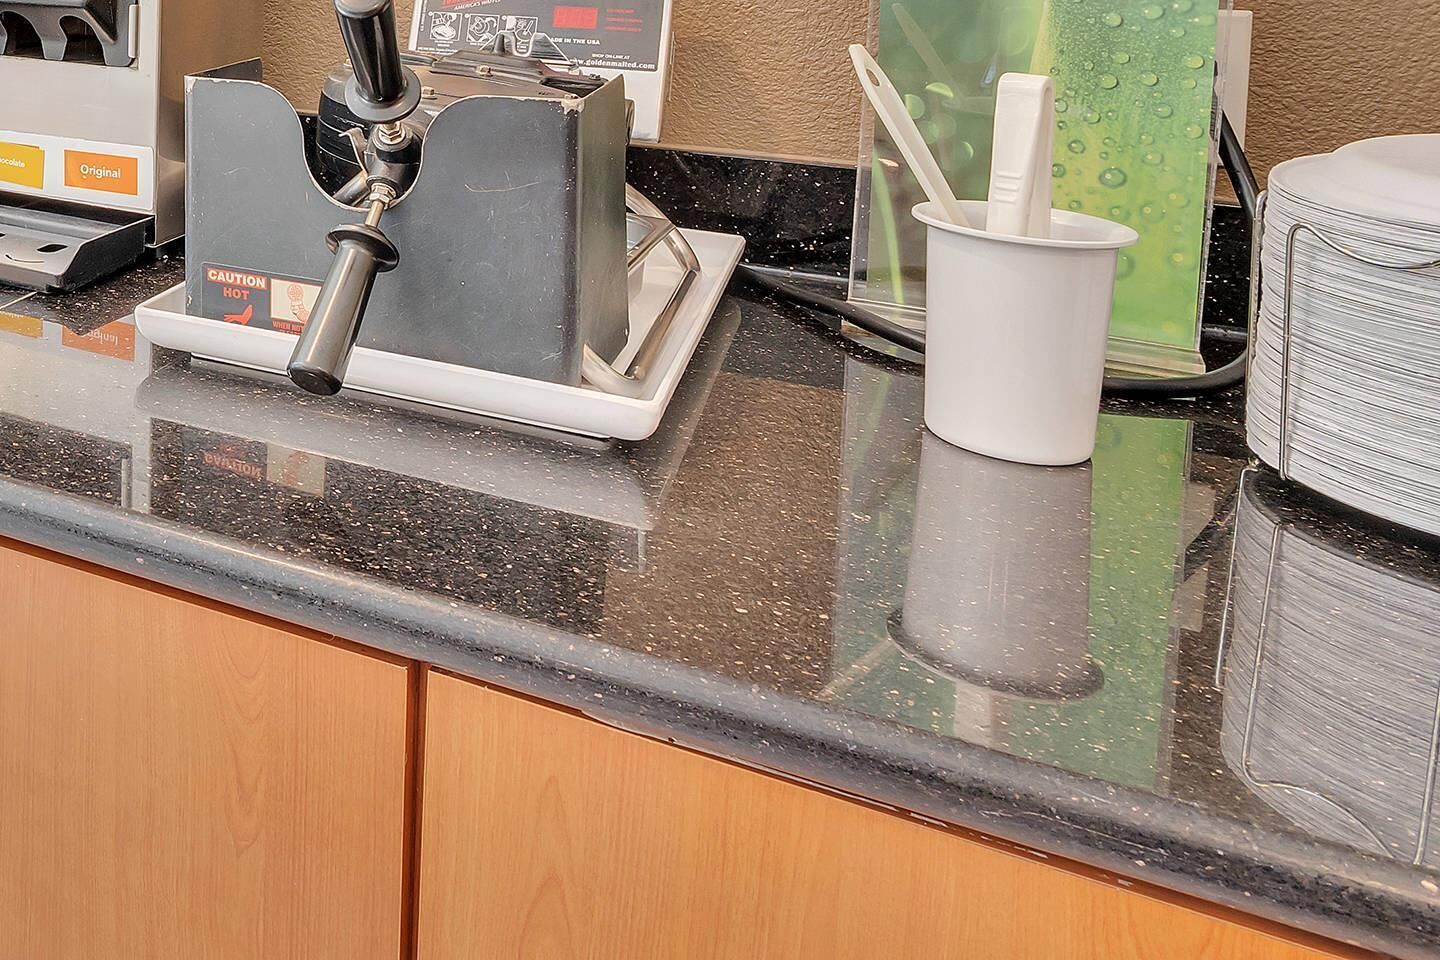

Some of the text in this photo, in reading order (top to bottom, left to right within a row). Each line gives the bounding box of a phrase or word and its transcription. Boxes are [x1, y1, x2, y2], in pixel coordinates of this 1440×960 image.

[80, 164, 122, 179] Original
[208, 269, 266, 289] CAUTION
[223, 286, 250, 301] HOT
